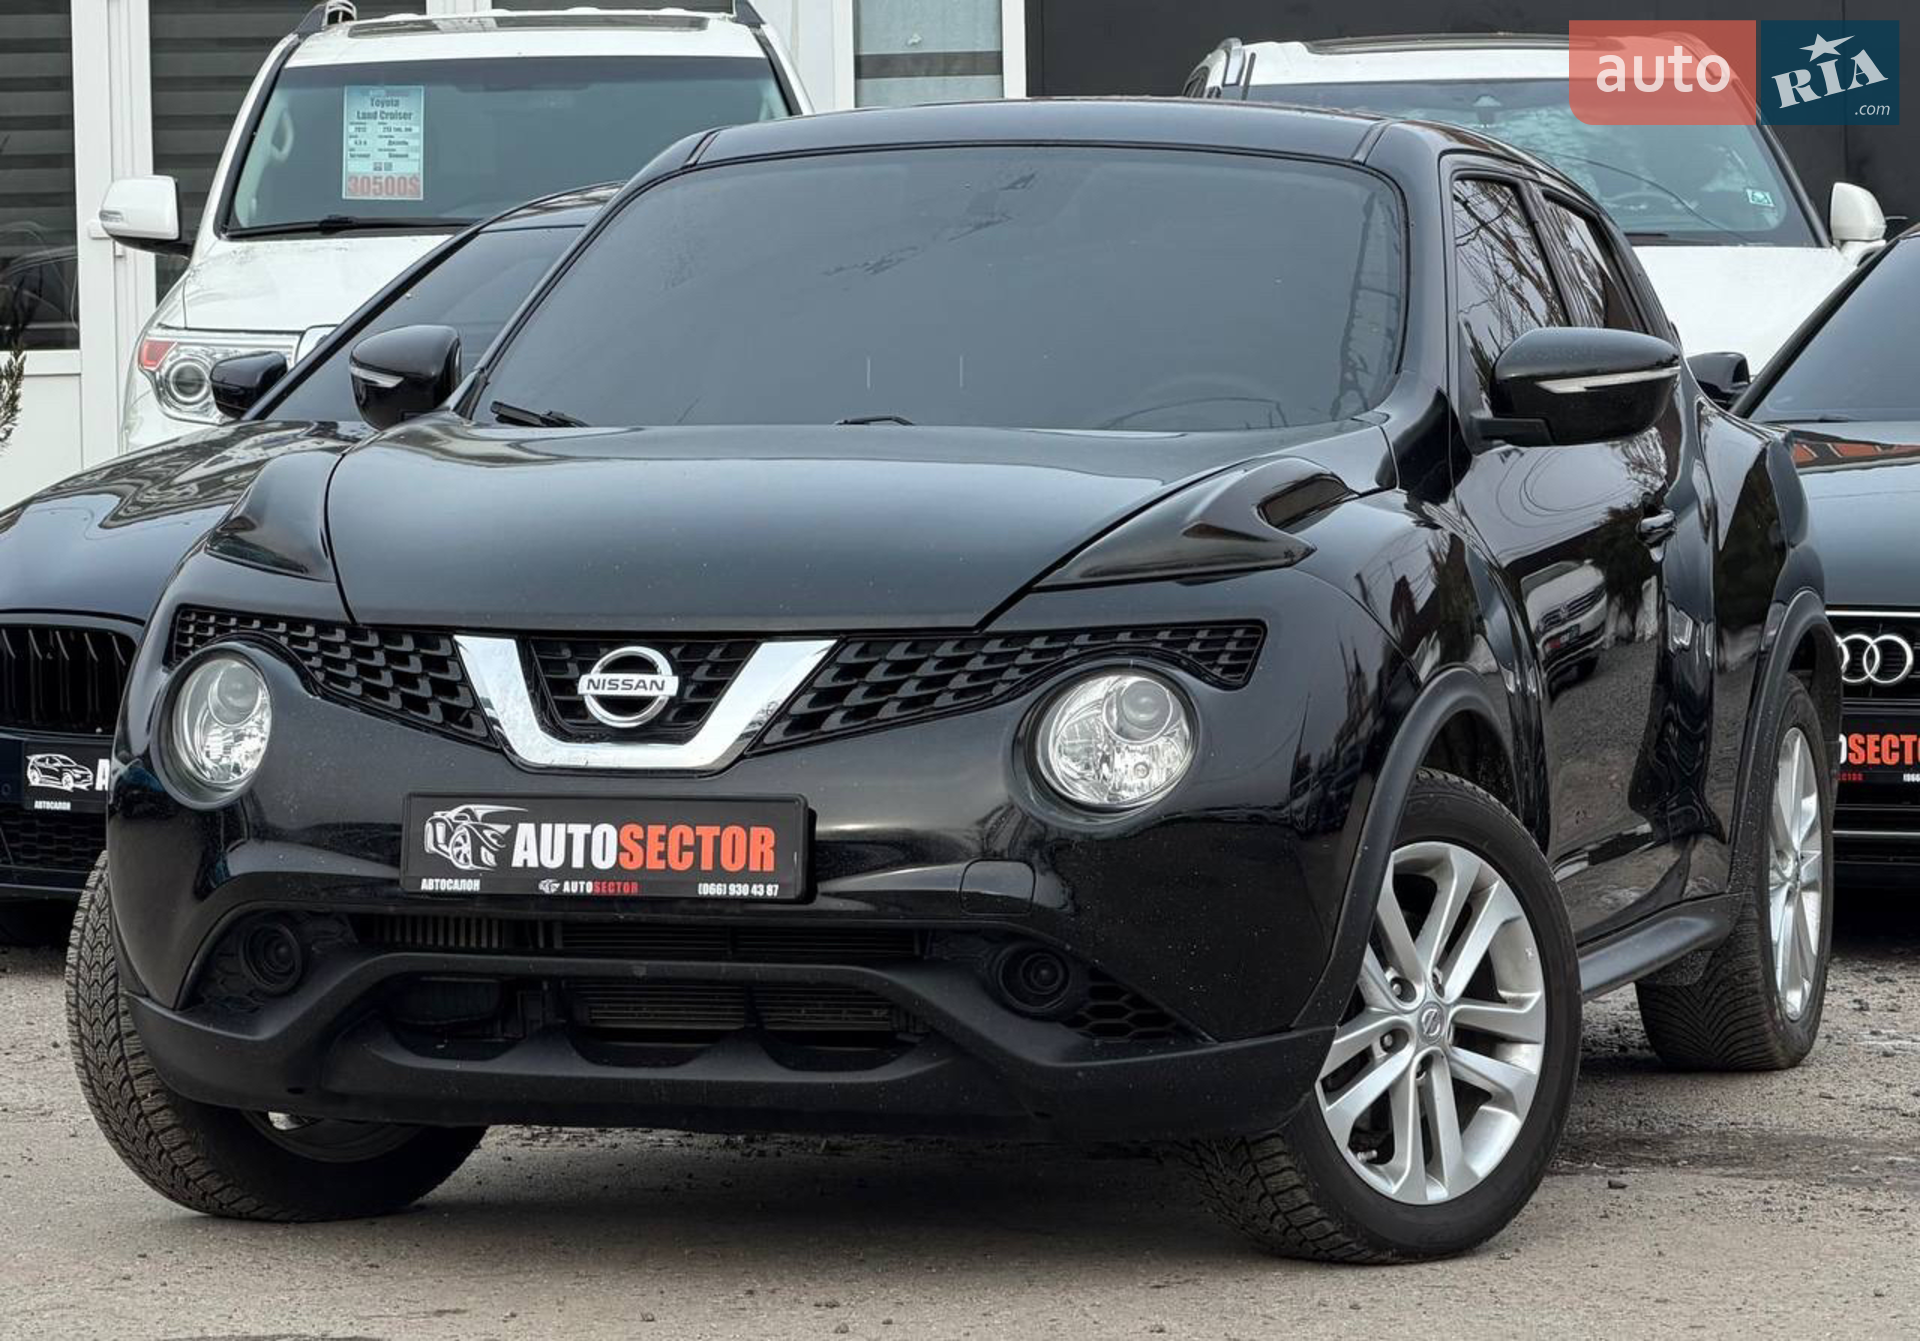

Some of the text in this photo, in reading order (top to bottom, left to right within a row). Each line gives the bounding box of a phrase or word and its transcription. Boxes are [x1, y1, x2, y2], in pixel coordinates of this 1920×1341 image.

[370, 97, 400, 108] Toyota
[357, 110, 412, 120] Land Cruiser
[347, 173, 420, 196] 30500$
[586, 678, 665, 691] NISSAN
[511, 823, 775, 872] AUTOSECTOR
[421, 878, 480, 891] АВТОСАЛОН
[562, 880, 639, 894] AUTOSECTOR
[728, 883, 749, 896] 930
[751, 884, 764, 896] 43
[766, 884, 779, 897] 87
